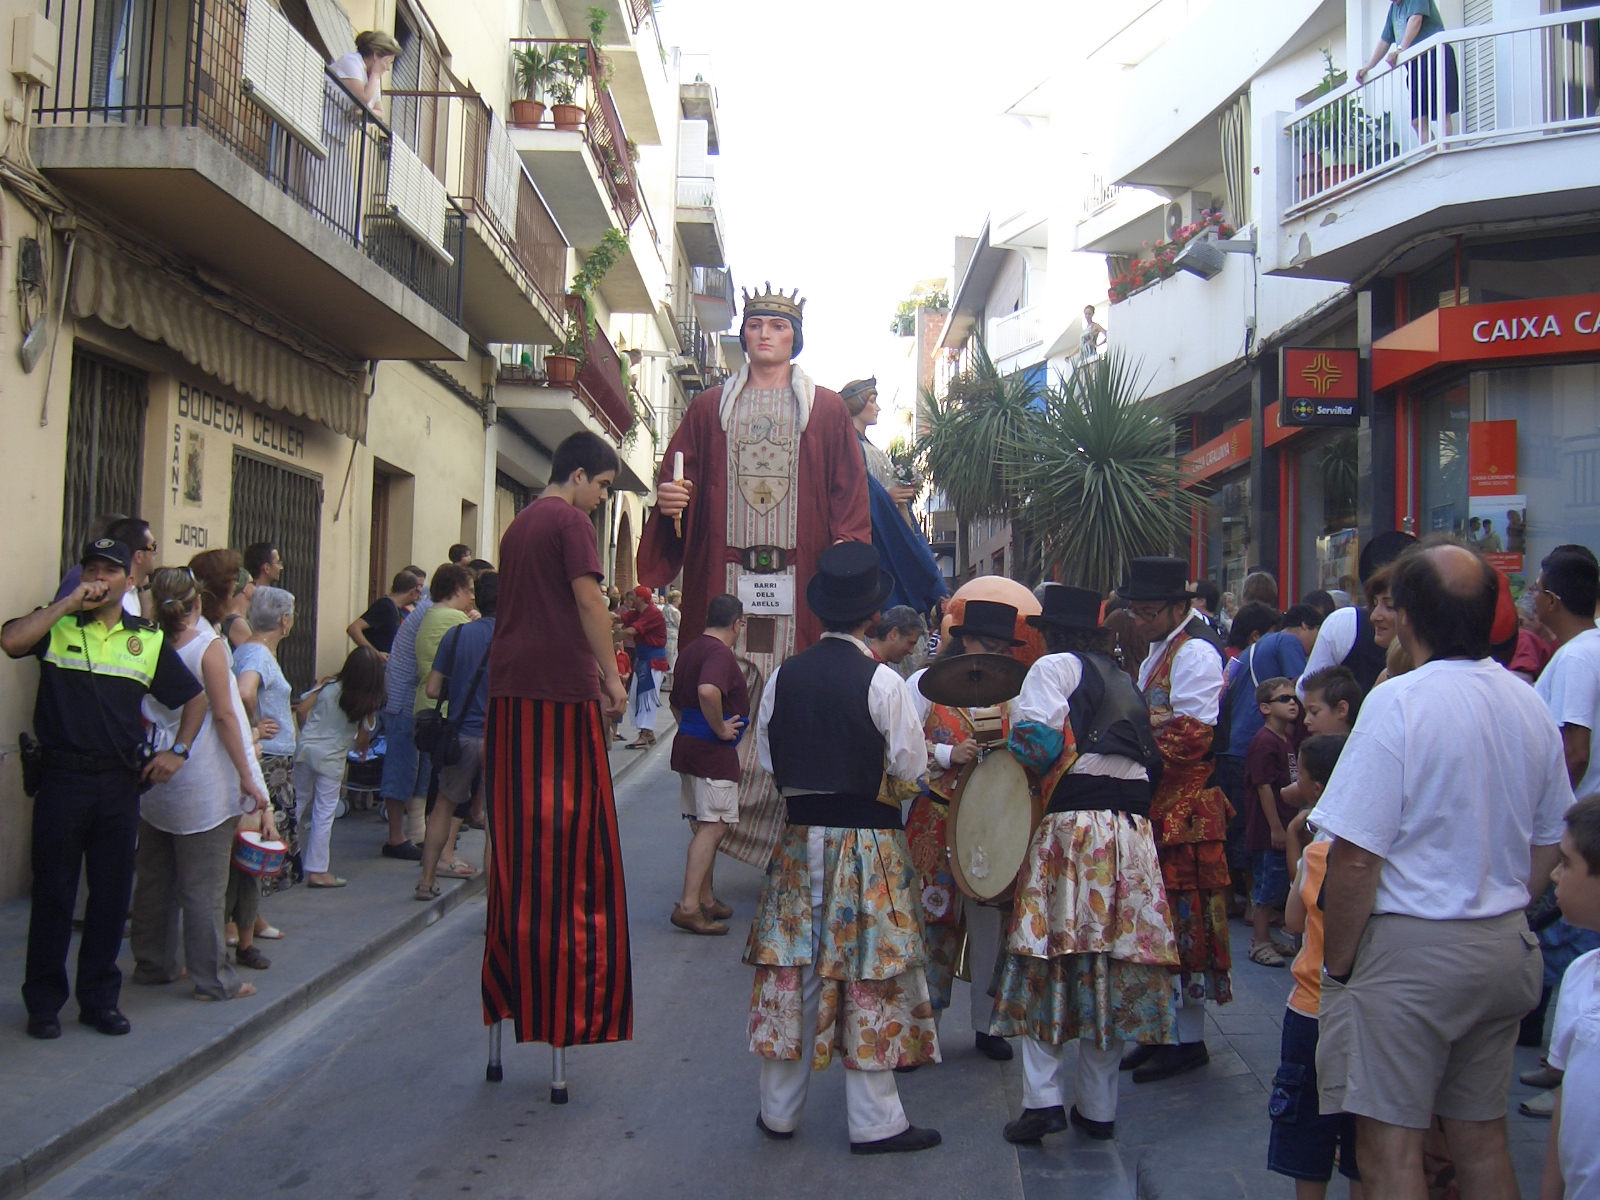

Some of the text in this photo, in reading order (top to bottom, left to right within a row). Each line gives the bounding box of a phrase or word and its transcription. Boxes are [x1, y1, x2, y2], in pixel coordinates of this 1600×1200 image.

[1472, 315, 1561, 343] CAIXA
[178, 381, 304, 459] BODEGA CELLER
[1316, 405, 1353, 415] ServiRed
[172, 423, 181, 506] SANT
[175, 523, 208, 549] JORDI
